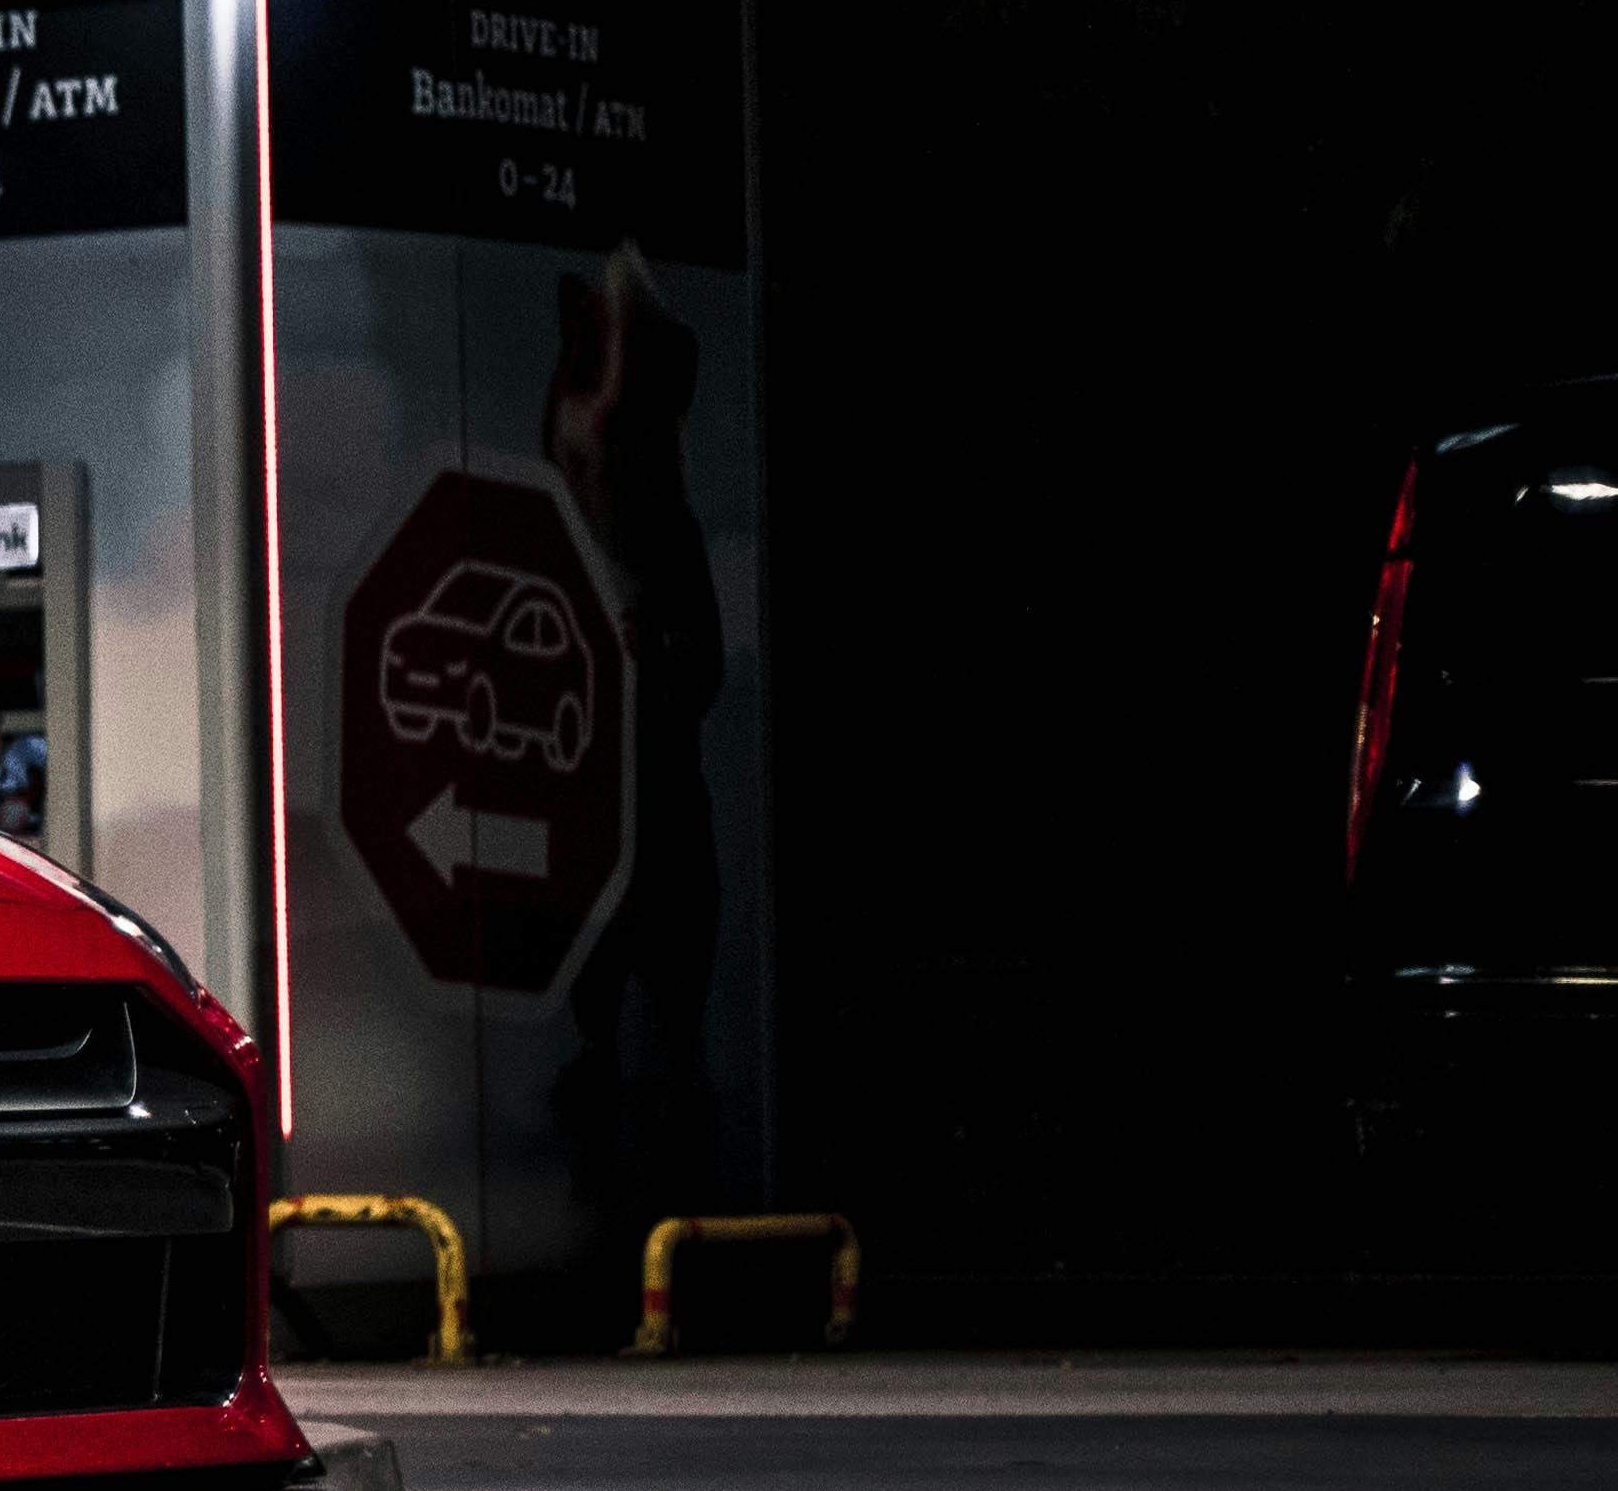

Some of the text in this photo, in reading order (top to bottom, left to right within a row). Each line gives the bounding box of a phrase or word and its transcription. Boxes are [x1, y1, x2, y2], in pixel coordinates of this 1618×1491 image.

[467, 7, 601, 65] DRIVE-IN
[27, 74, 120, 124] ATM
[409, 65, 571, 131] Bankomat
[593, 98, 648, 144] ATM
